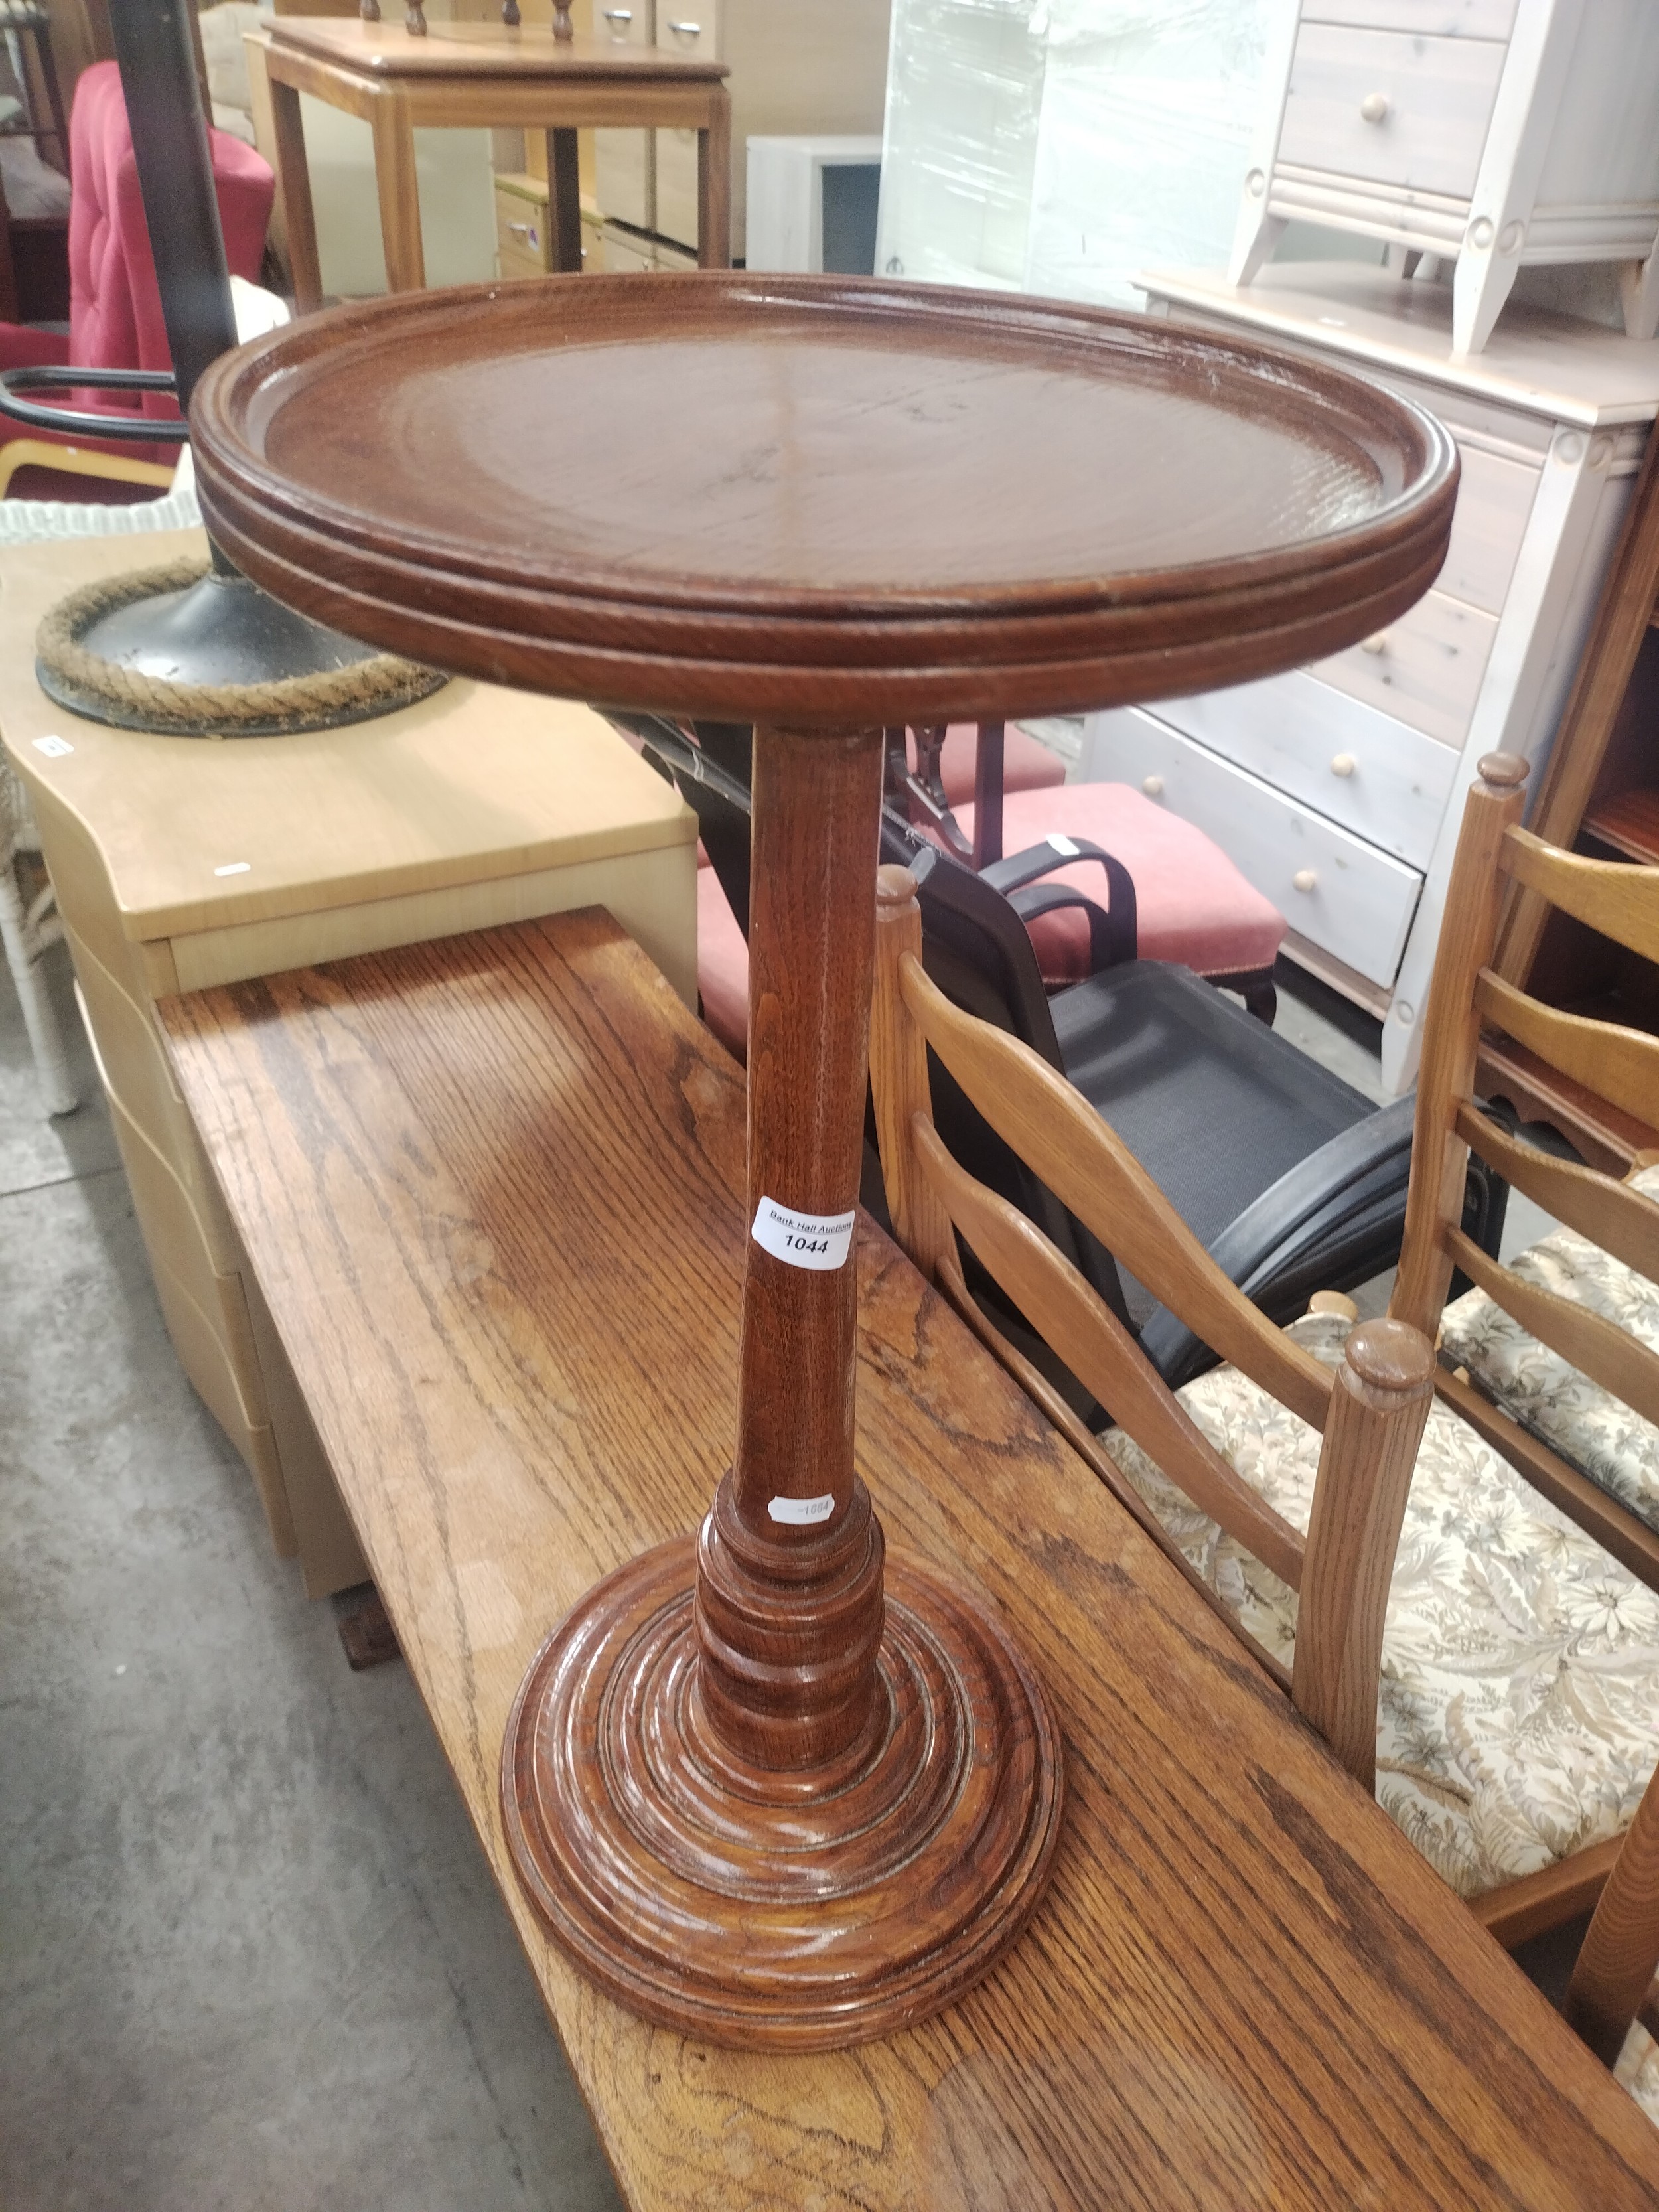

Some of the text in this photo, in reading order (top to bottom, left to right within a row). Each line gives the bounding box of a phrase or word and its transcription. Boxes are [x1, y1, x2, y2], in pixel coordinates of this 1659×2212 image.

[770, 1210, 852, 1234] Bank Hall Auctions
[785, 1234, 828, 1253] 1044
